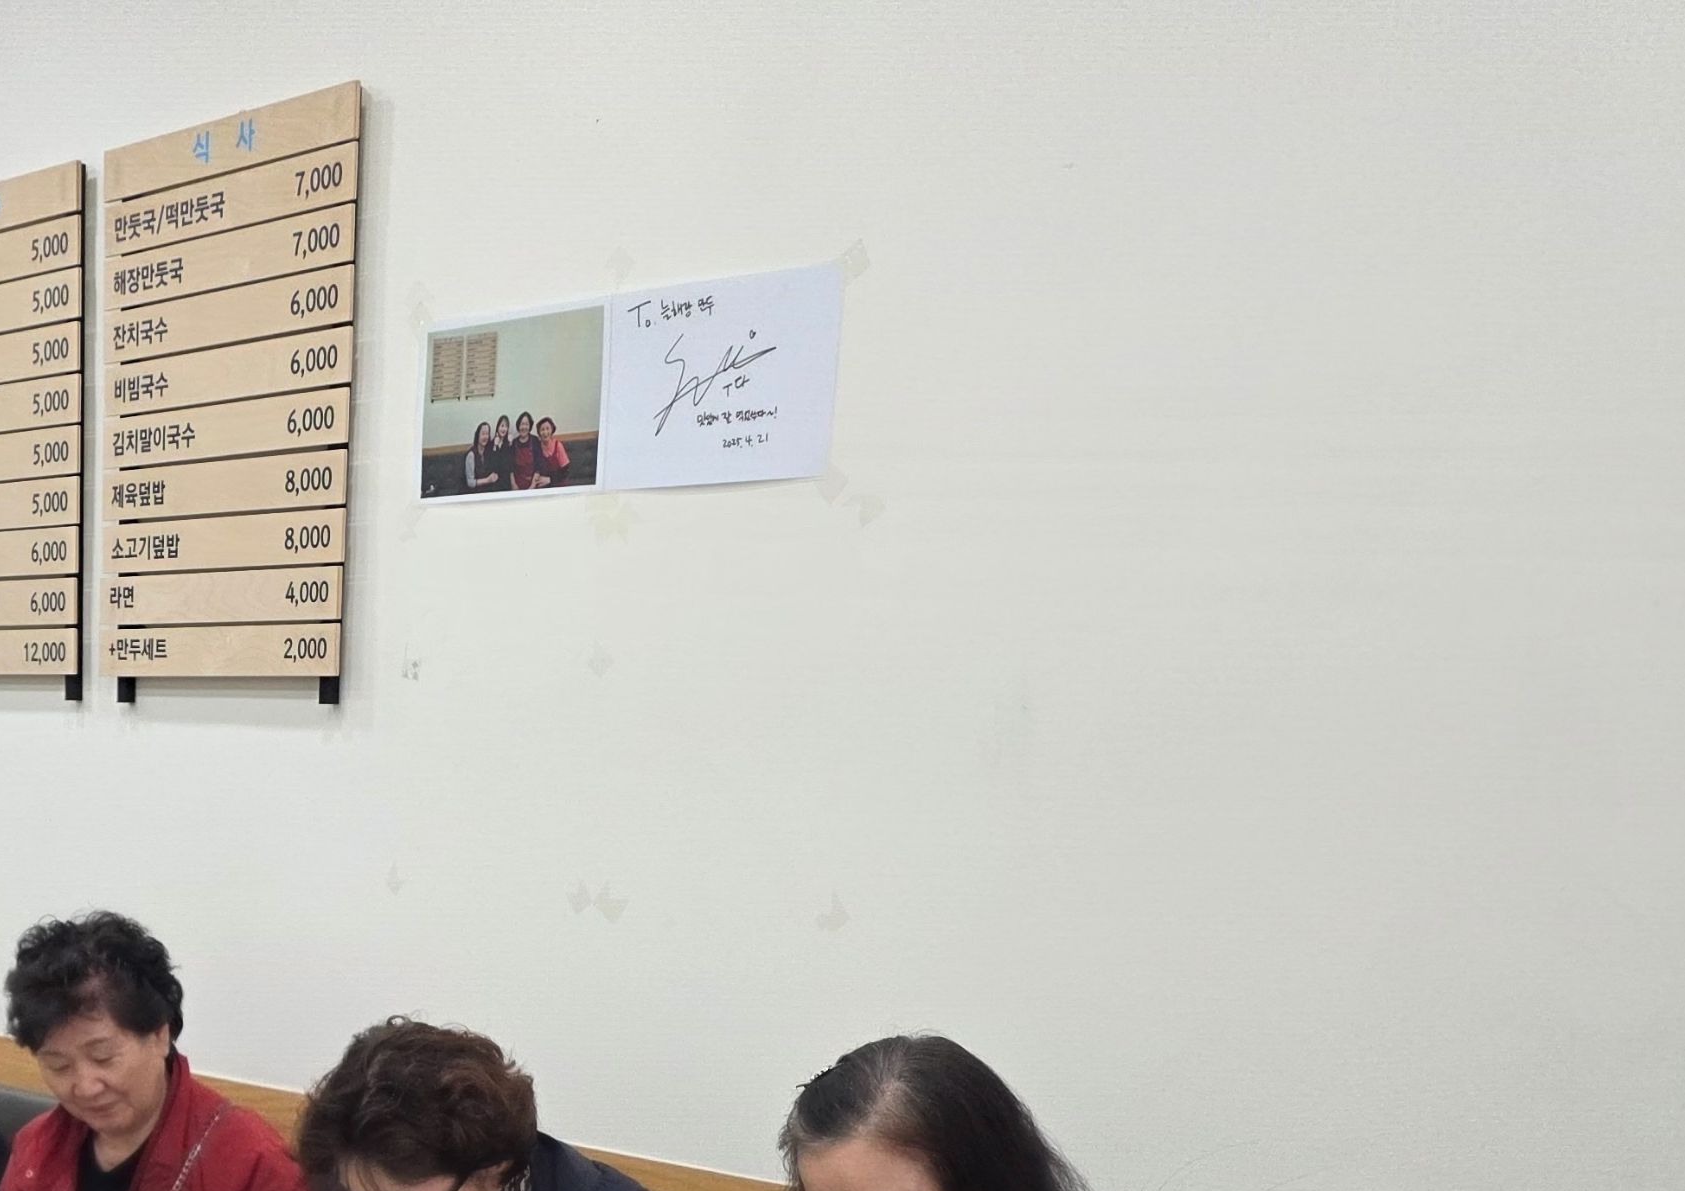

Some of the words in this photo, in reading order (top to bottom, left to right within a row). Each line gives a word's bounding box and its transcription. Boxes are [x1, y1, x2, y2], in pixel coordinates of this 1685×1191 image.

[114, 191, 225, 243] 만둣국/떡만둣국
[295, 161, 342, 197] 7,000
[32, 232, 68, 263] 5,000
[114, 259, 183, 295] 해장만둣국
[293, 223, 340, 258] 7,000
[33, 284, 69, 314] 5,000
[113, 318, 168, 350] 잔치국수
[291, 284, 338, 316] 6,000
[33, 337, 69, 366] 5,000
[114, 372, 168, 403] 비빔국수
[291, 344, 337, 376] 6,000
[33, 390, 69, 416] 5,000
[113, 422, 195, 456] 김치말이국수
[287, 405, 334, 435] 6,000
[33, 440, 69, 465] 5,000
[111, 480, 165, 508] 제육덮밥
[285, 466, 332, 494] 8,000
[32, 491, 68, 517] 5,000
[31, 540, 67, 563] 6,000
[111, 533, 180, 560] 소고기덮밥
[285, 524, 330, 551] 8,000
[31, 591, 66, 614] 6,000
[110, 586, 134, 609] 라면
[285, 581, 329, 605] 4,000
[24, 642, 66, 663] 12,000
[284, 637, 327, 660] 2,000
